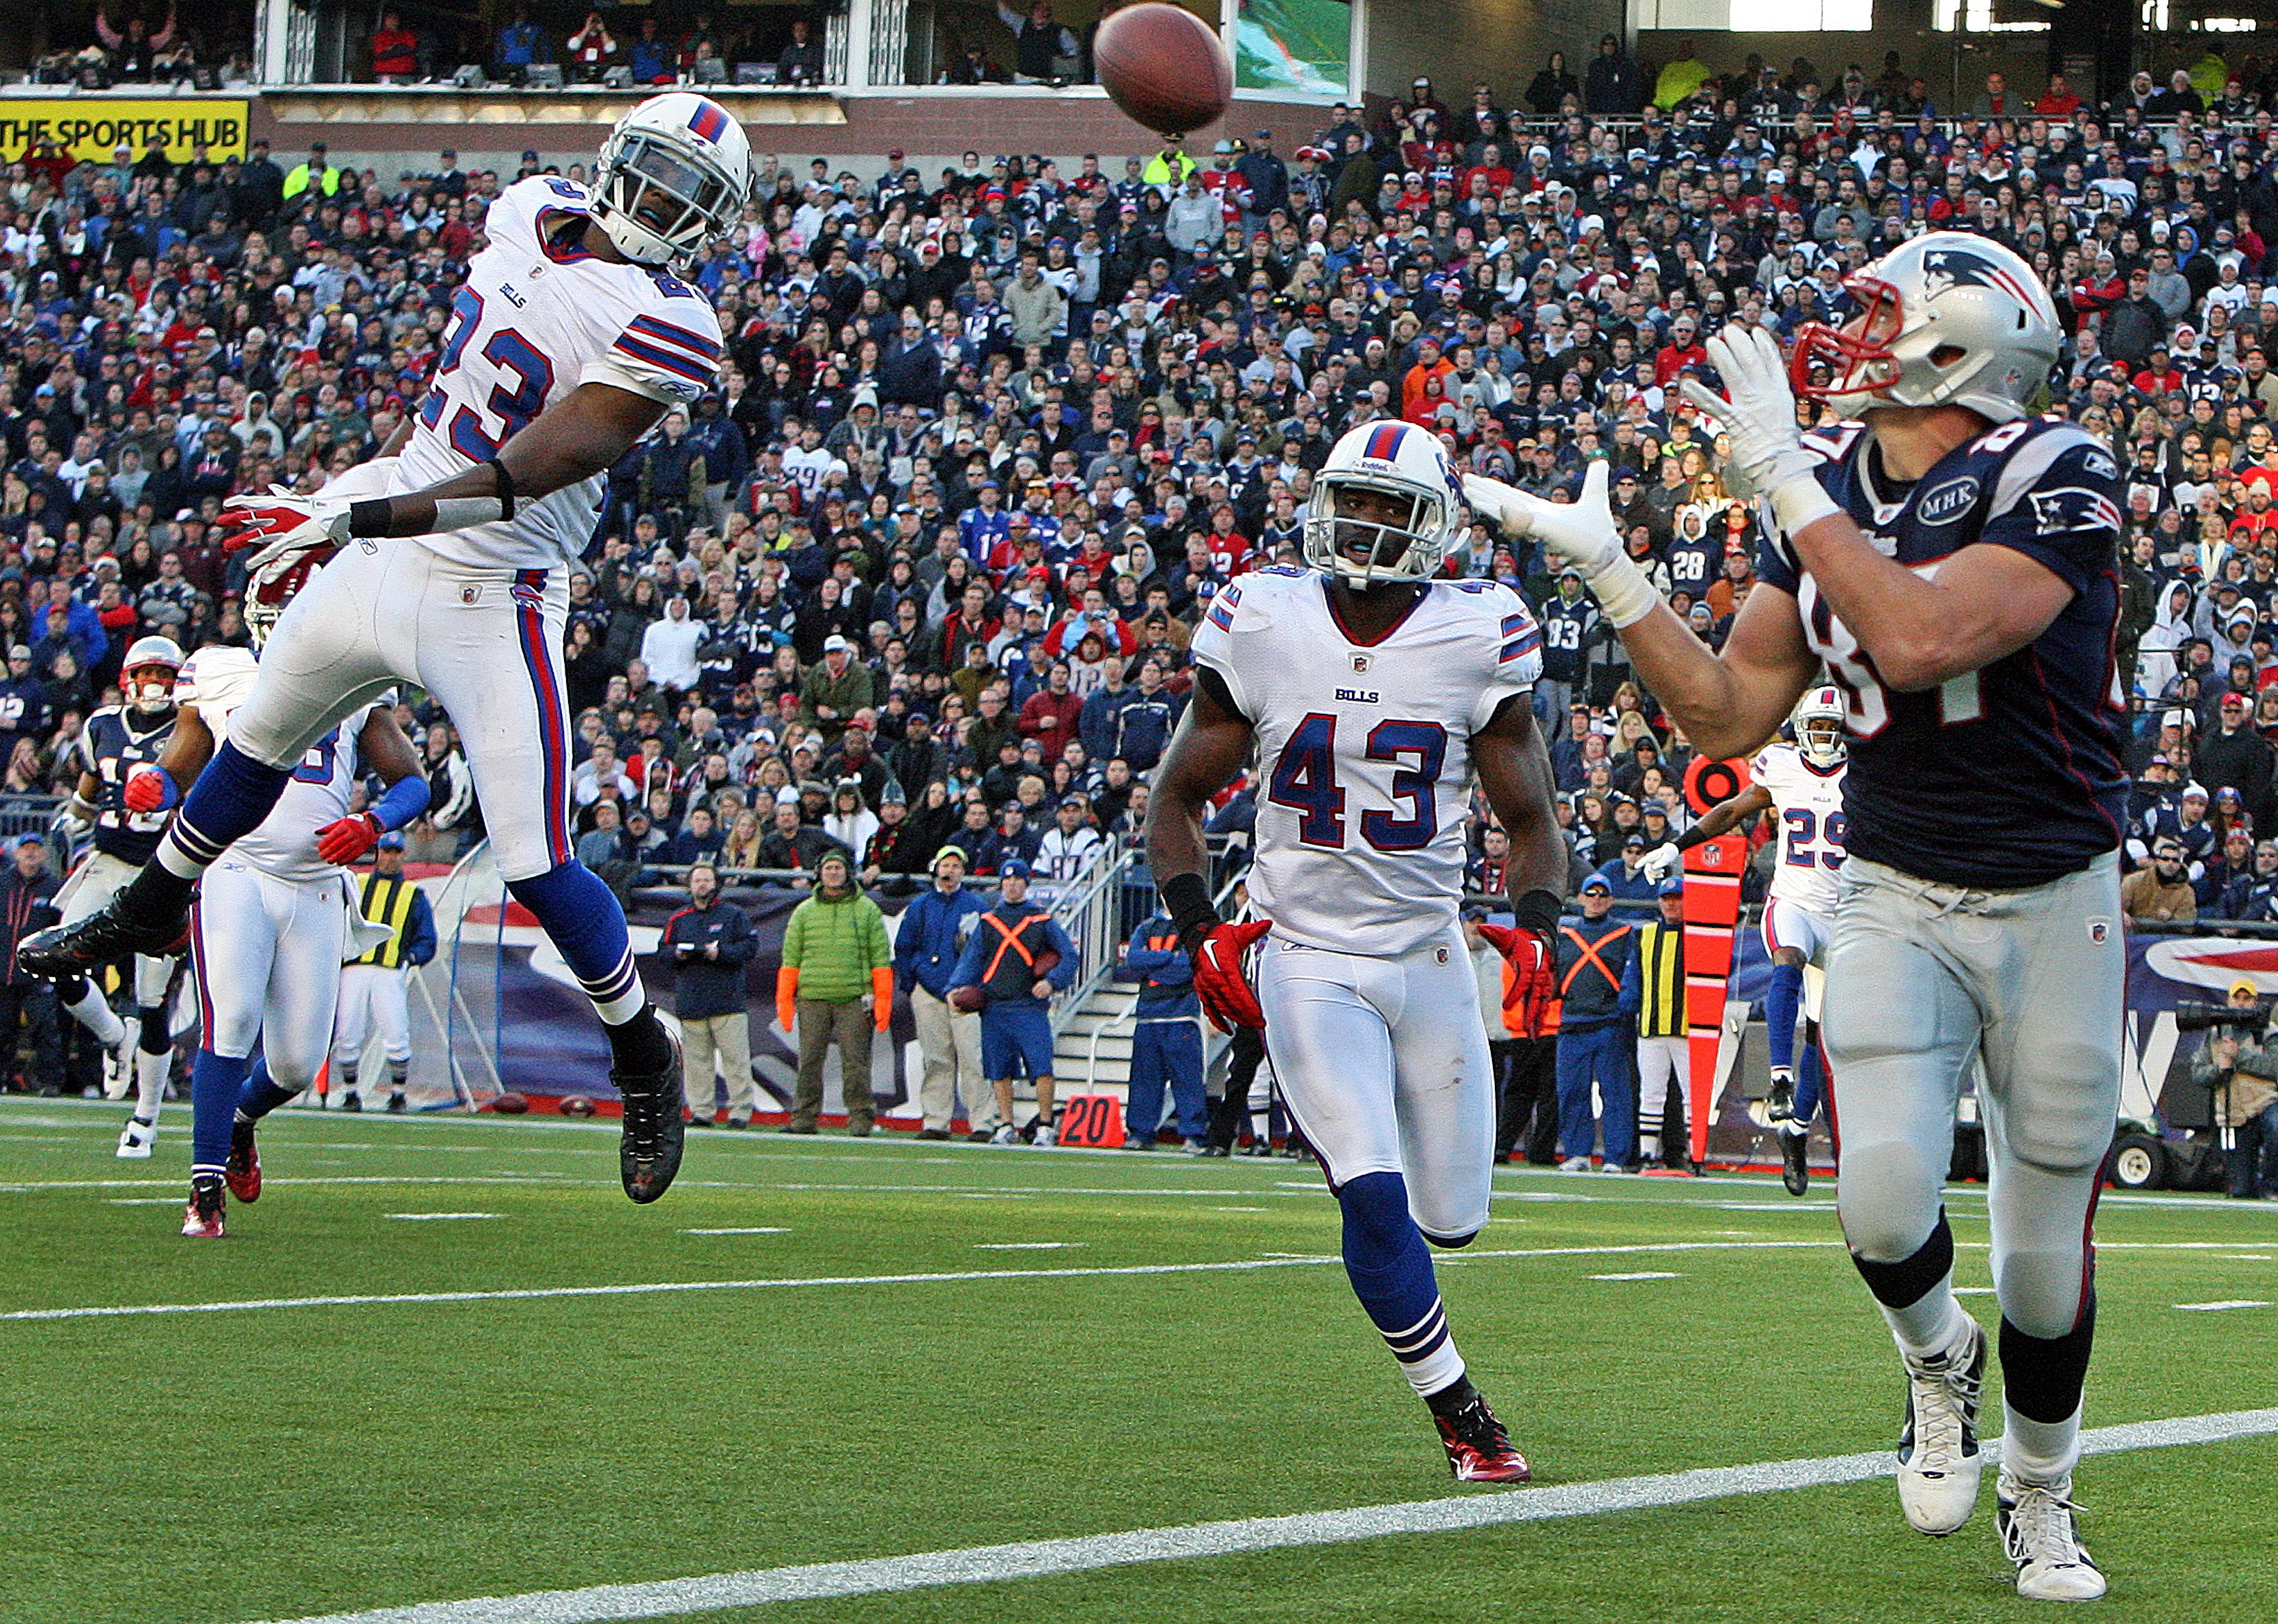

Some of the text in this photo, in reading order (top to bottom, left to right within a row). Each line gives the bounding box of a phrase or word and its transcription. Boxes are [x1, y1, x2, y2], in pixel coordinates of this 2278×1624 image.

[0, 119, 238, 148] THE SPORTS HUB
[499, 283, 526, 309] BILLS
[421, 285, 555, 464] 23
[1924, 484, 1972, 518] MHK
[1673, 550, 1706, 580] 28
[1548, 618, 1581, 651] 83
[1335, 688, 1379, 703] BILLS
[1268, 712, 1448, 851] 43
[1783, 808, 1847, 870] 29
[1065, 1097, 1109, 1143] 20
